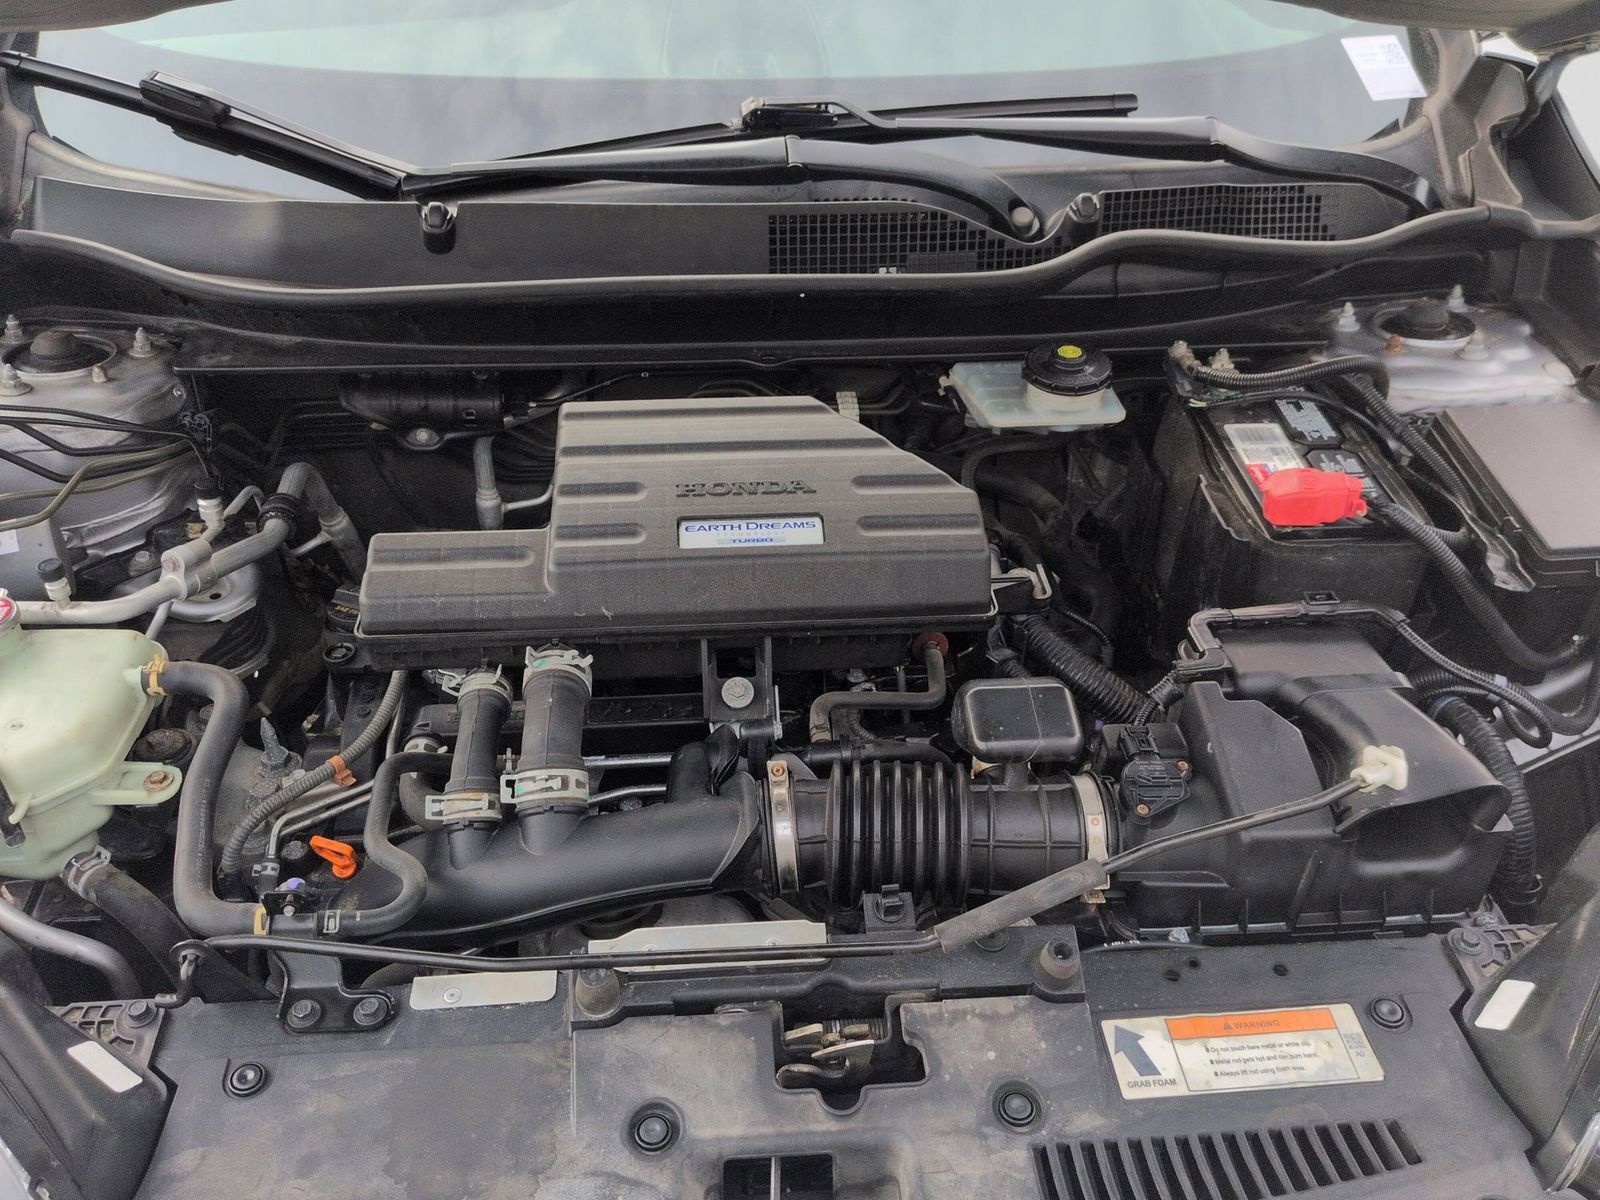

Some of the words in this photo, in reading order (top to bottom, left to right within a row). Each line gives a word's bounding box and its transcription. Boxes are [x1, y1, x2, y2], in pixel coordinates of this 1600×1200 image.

[676, 480, 816, 498] HONDA
[685, 524, 741, 532] EARTH
[746, 521, 816, 530] DREAMS
[1233, 1020, 1280, 1029] WARNING
[1128, 1079, 1151, 1088] GRAB
[1153, 1078, 1176, 1087] FOAM
